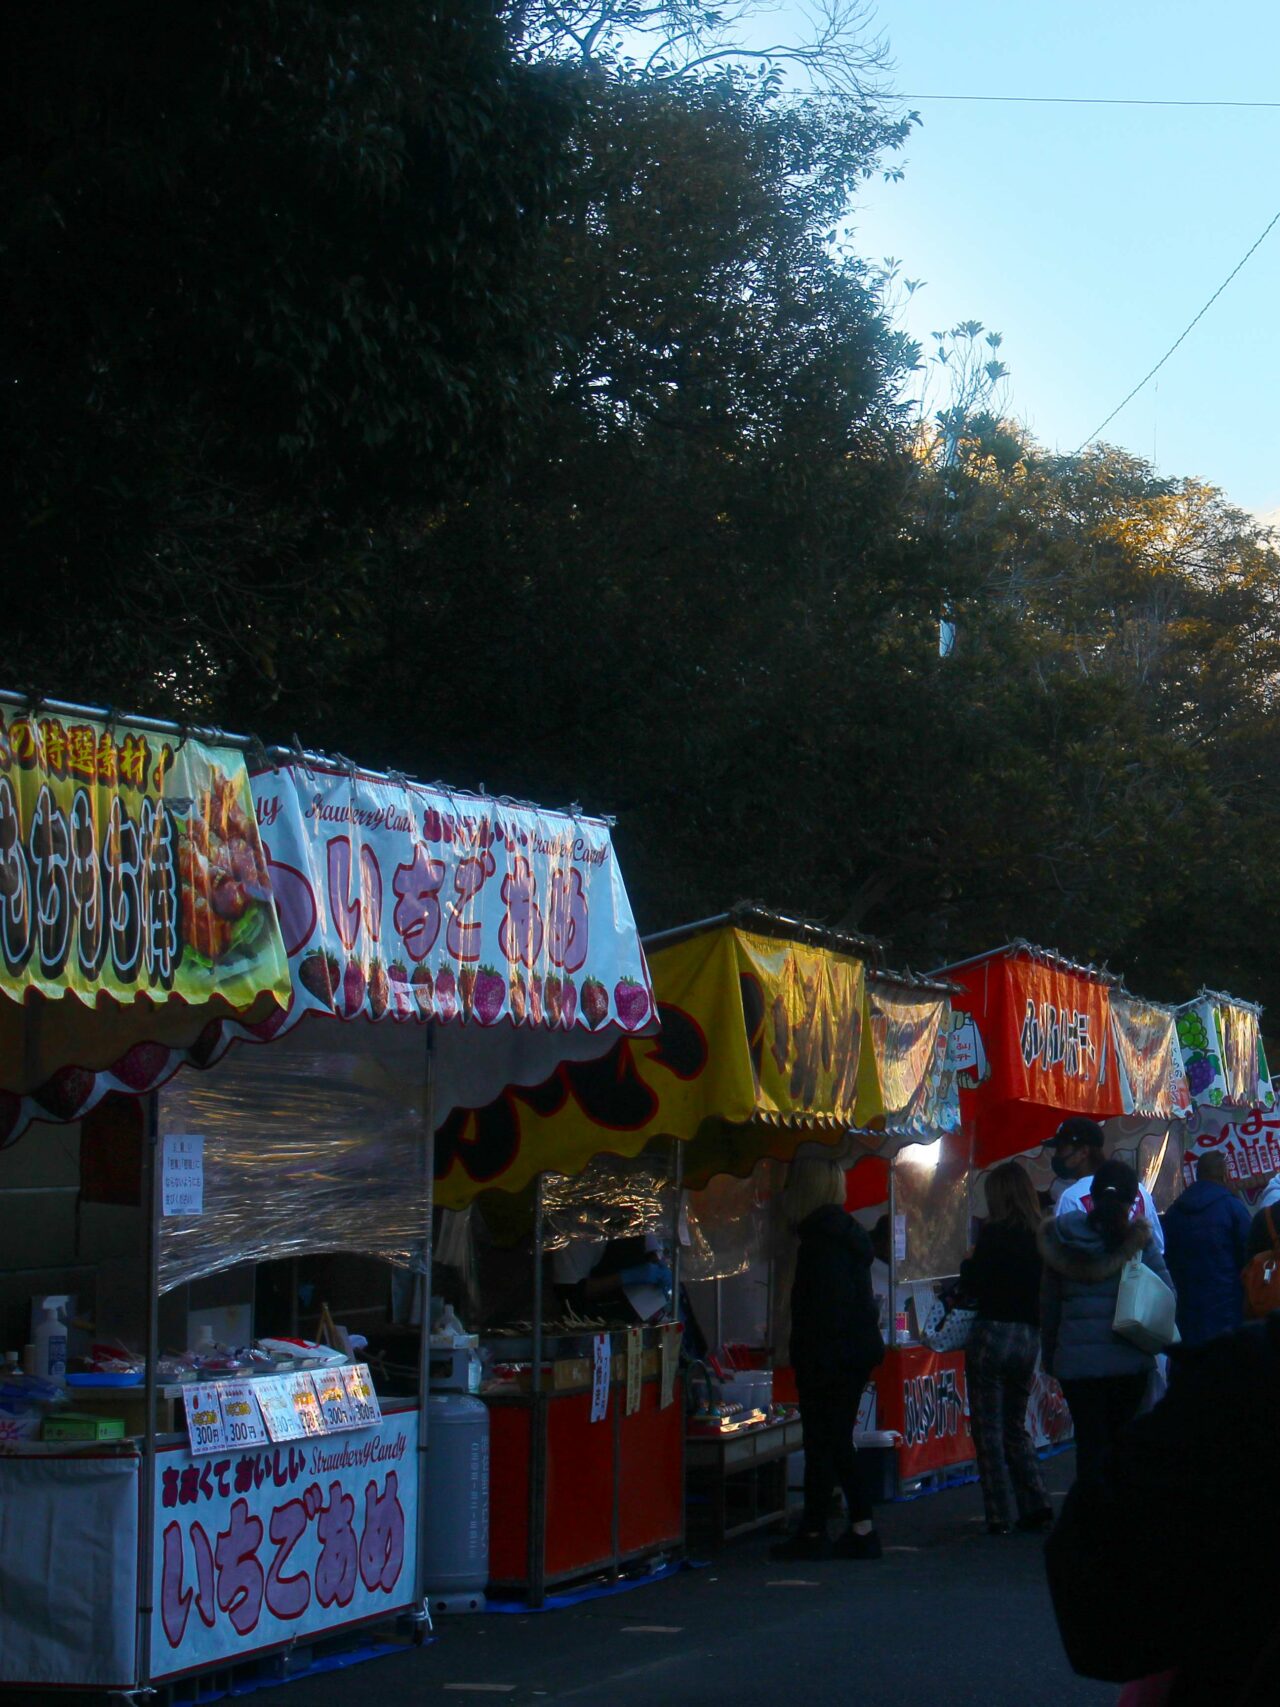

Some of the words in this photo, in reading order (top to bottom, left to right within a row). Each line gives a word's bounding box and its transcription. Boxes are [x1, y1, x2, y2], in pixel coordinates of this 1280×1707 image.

[0, 716, 172, 791] の特選素材!
[326, 834, 588, 974] いちごあめ
[195, 1425, 220, 1445] 300円
[228, 1422, 257, 1442] 300円
[161, 1470, 405, 1648] いちごあめ
